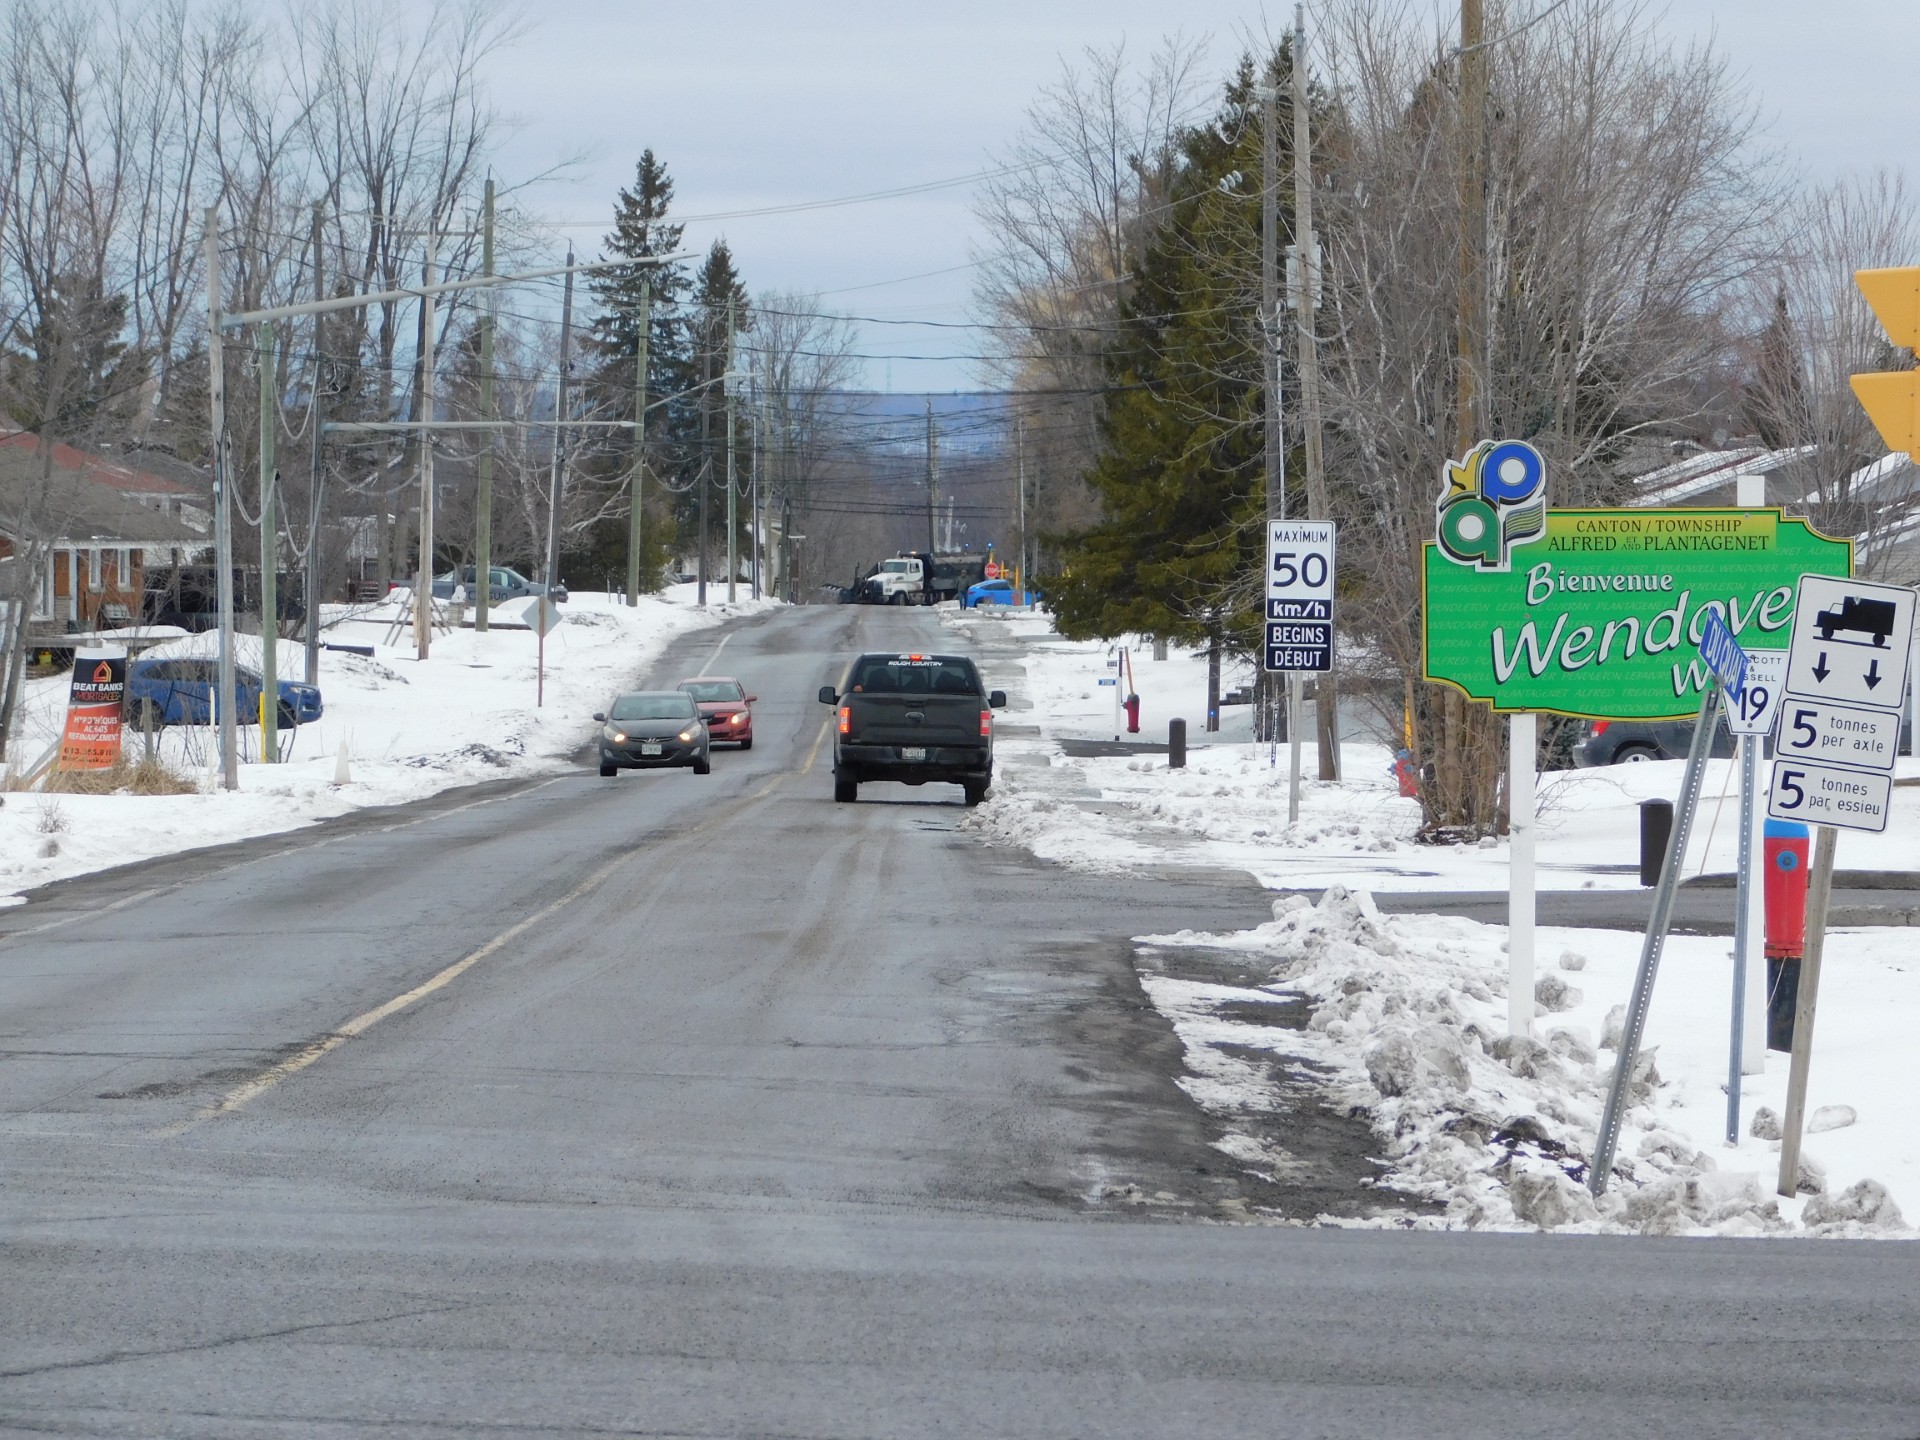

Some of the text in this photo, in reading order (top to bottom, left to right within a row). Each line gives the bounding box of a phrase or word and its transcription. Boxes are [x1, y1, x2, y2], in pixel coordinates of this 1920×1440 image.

[1576, 519, 1643, 532] CANTON
[1655, 519, 1742, 532] TOWNSHIP
[1274, 530, 1328, 543] MAXIMUM
[1548, 536, 1617, 551] ALFRED
[1643, 536, 1769, 550] PLANTAGENET
[1621, 543, 1641, 551] AND
[1272, 552, 1328, 588] 50
[1524, 562, 1673, 606] Bienvenue
[1273, 601, 1326, 617] km/h
[1272, 626, 1325, 643] BEGINS
[1706, 621, 1725, 667] DU
[1274, 647, 1322, 667] DÉBUT
[73, 682, 124, 691] BEAT BANKS
[1740, 687, 1769, 721] 19
[1790, 709, 1877, 748] 5 tonnes
[1822, 734, 1884, 753] per axle
[1778, 770, 1868, 809] 5 tonnes
[1808, 795, 1880, 815] par essieu
